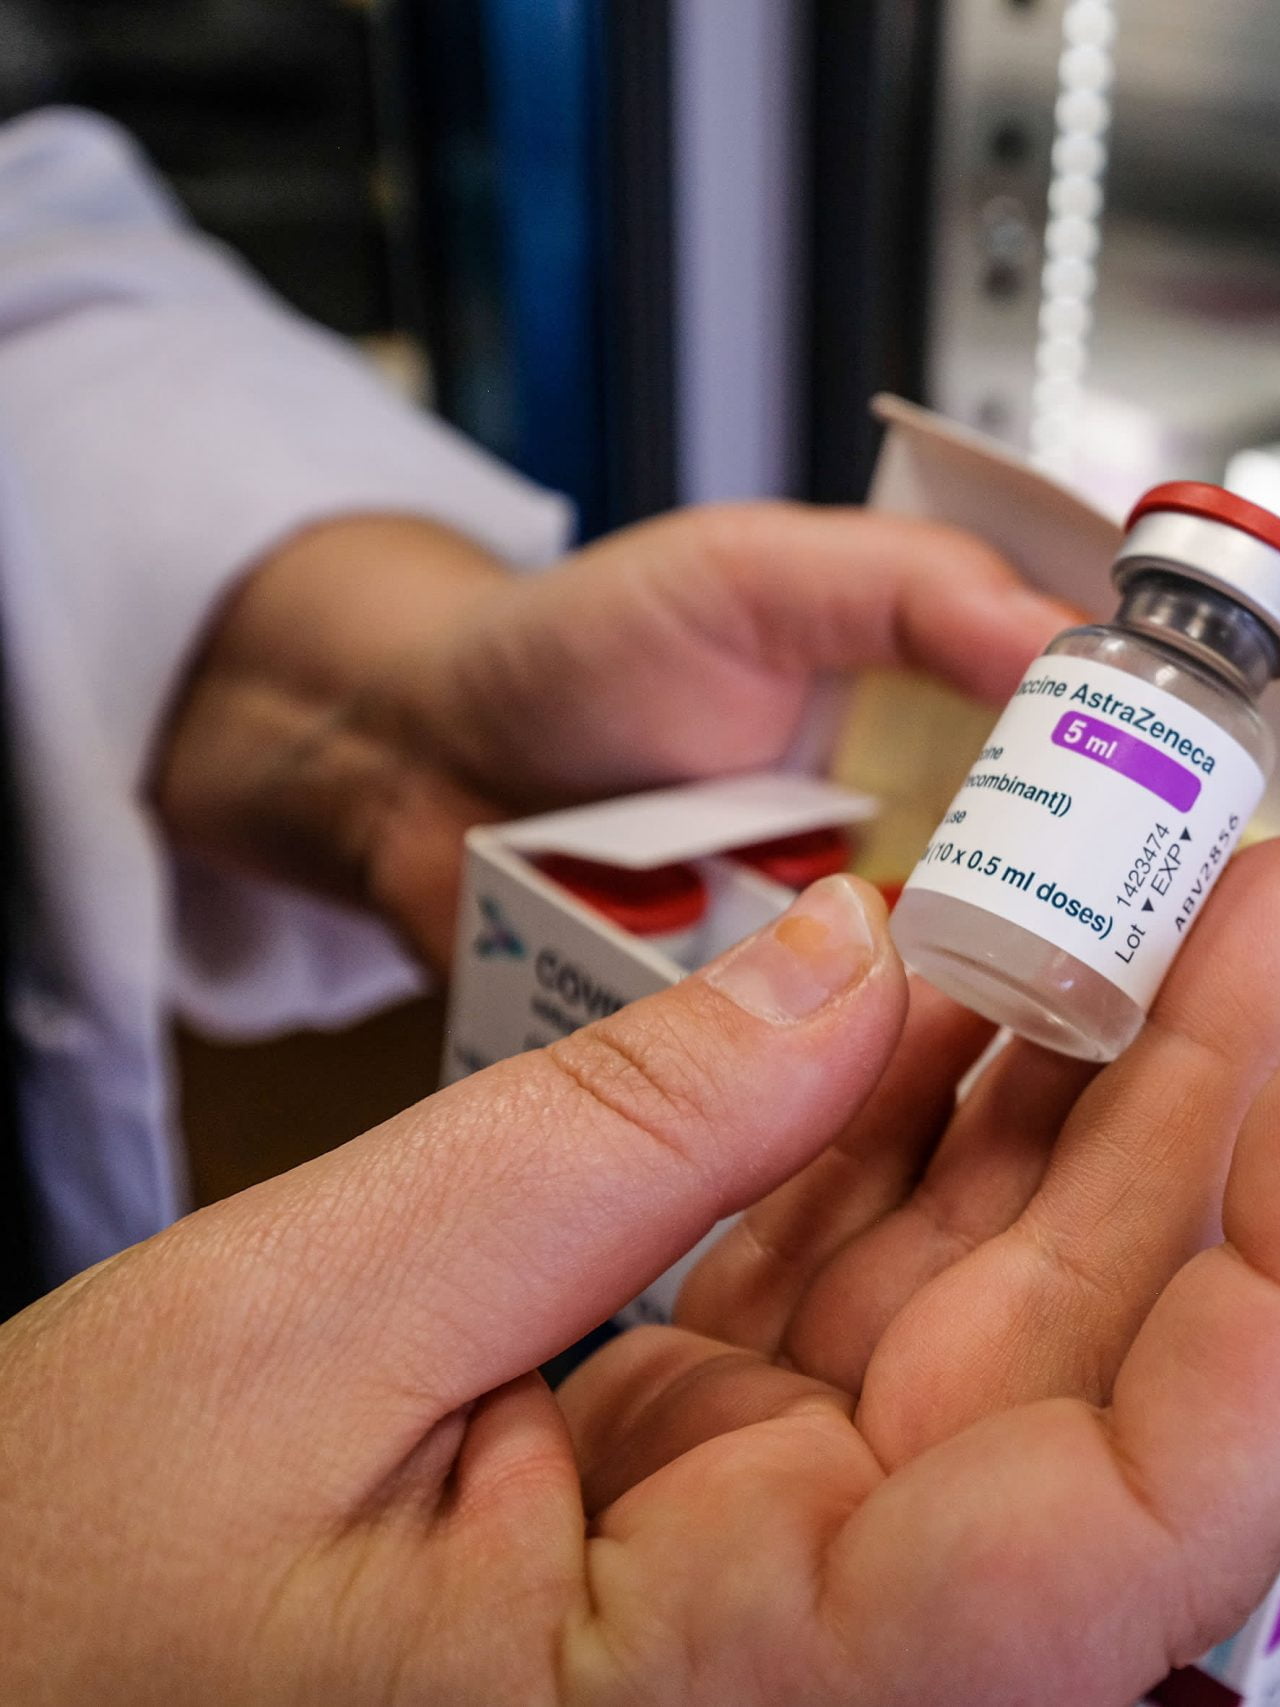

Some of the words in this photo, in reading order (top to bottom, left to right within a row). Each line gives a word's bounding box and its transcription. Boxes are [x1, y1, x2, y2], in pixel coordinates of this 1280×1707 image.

[1063, 719, 1088, 744] 5
[1085, 734, 1118, 759] ml
[1070, 683, 1216, 775] AstraZeneca
[951, 849, 966, 865] x
[967, 850, 1002, 876] 0.5
[1001, 866, 1035, 891] ml
[1036, 882, 1113, 940] doses)
[1114, 923, 1146, 964] Lot
[1150, 843, 1182, 896] EXP
[1116, 822, 1170, 907] 1423474
